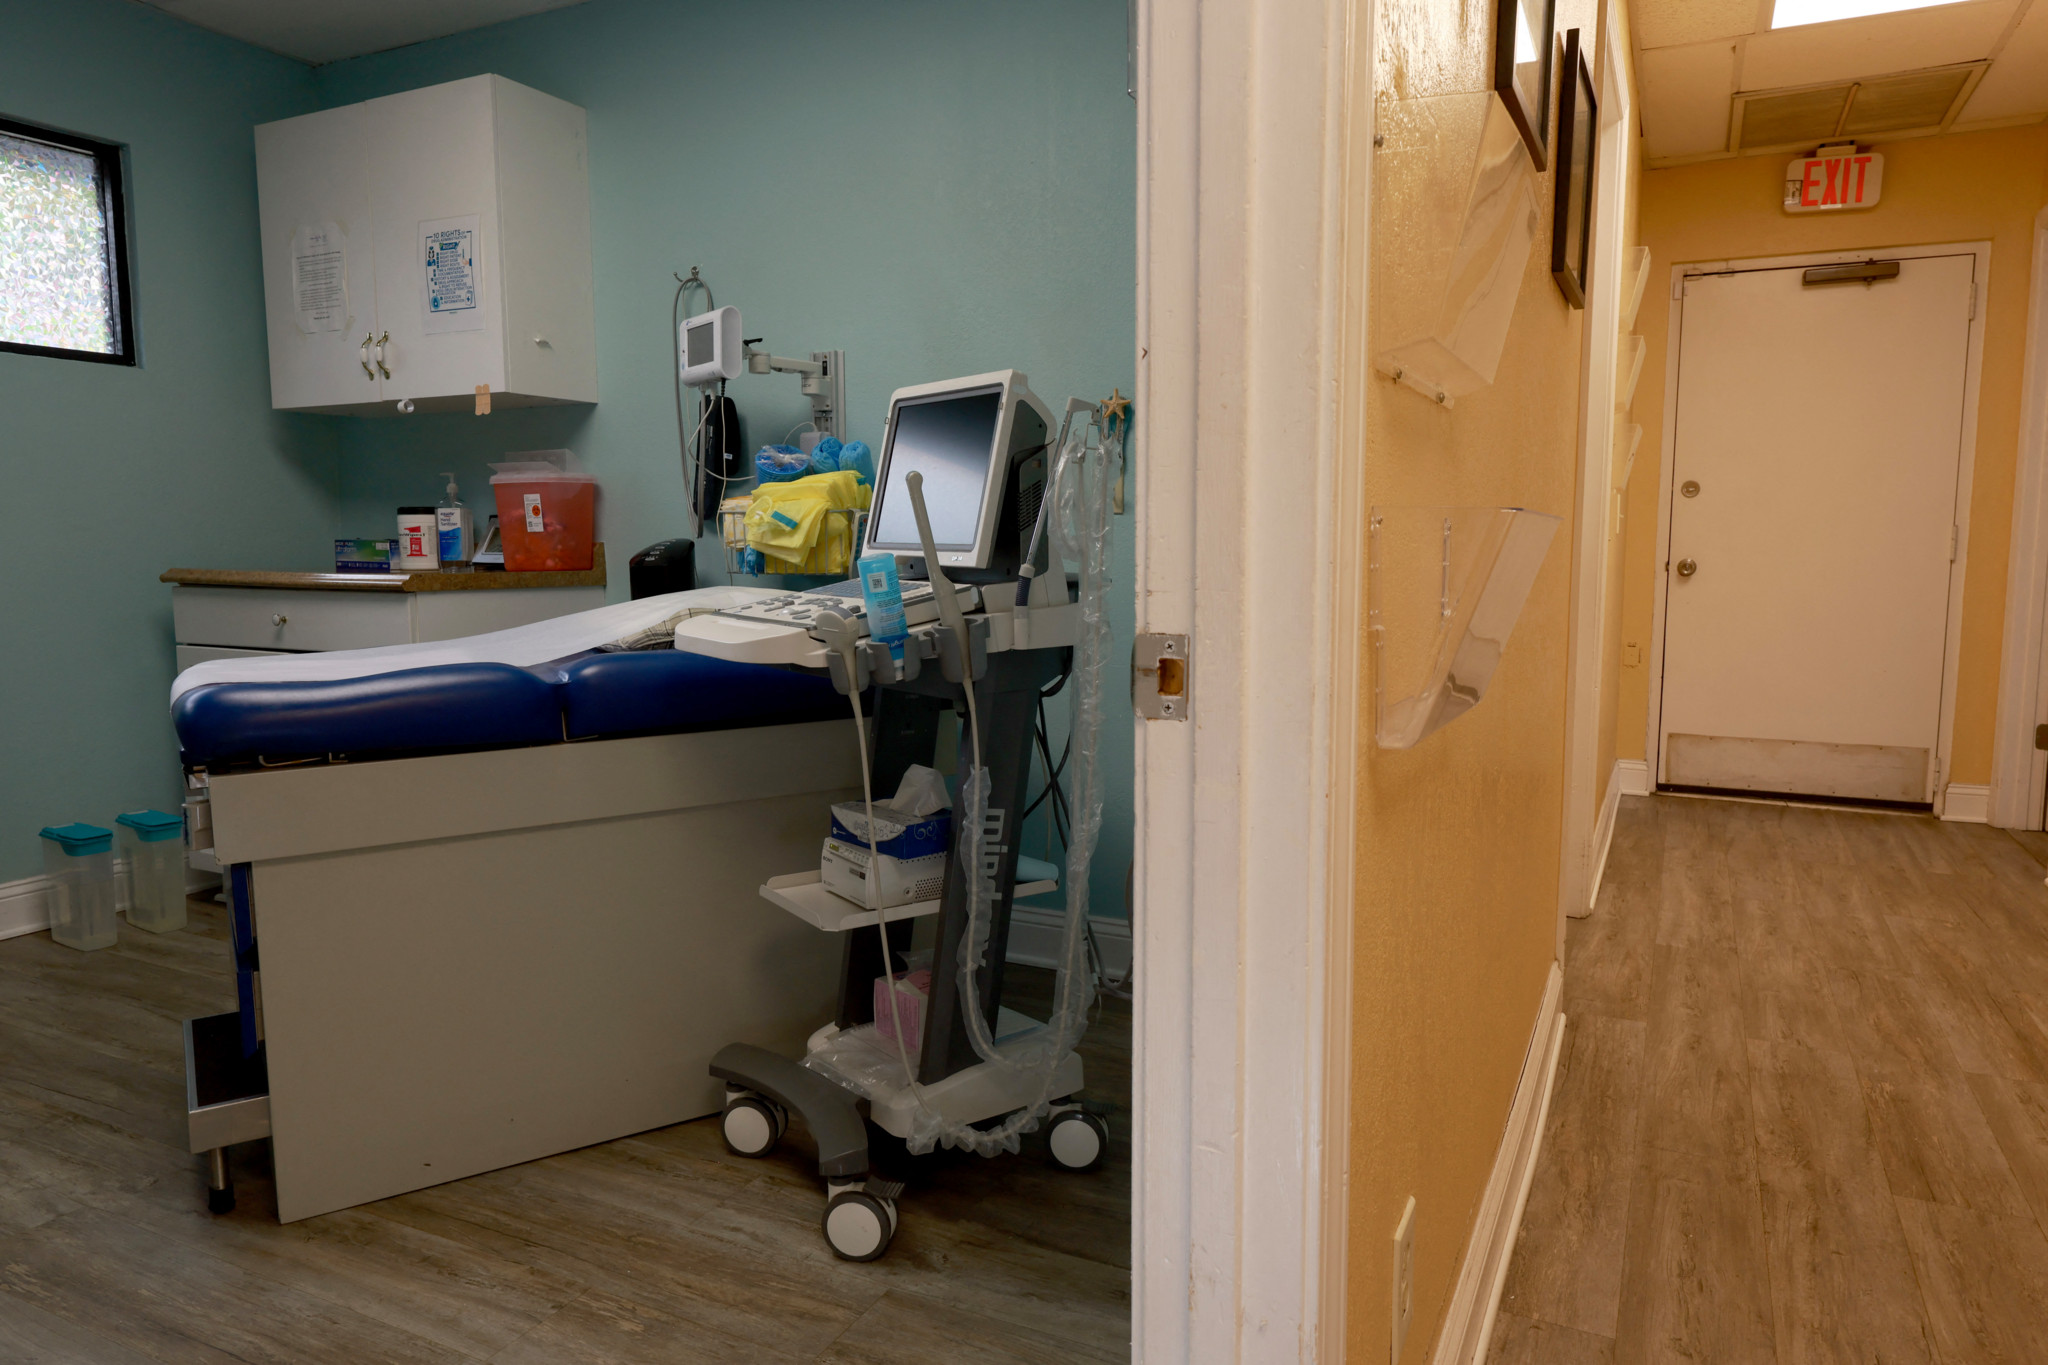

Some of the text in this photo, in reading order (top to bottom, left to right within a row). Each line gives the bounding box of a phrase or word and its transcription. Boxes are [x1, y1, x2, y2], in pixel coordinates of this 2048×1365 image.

[1801, 156, 1872, 207] EXIT
[433, 232, 440, 240] 10
[440, 229, 461, 238] RIGHTS
[822, 855, 833, 864] SONY
